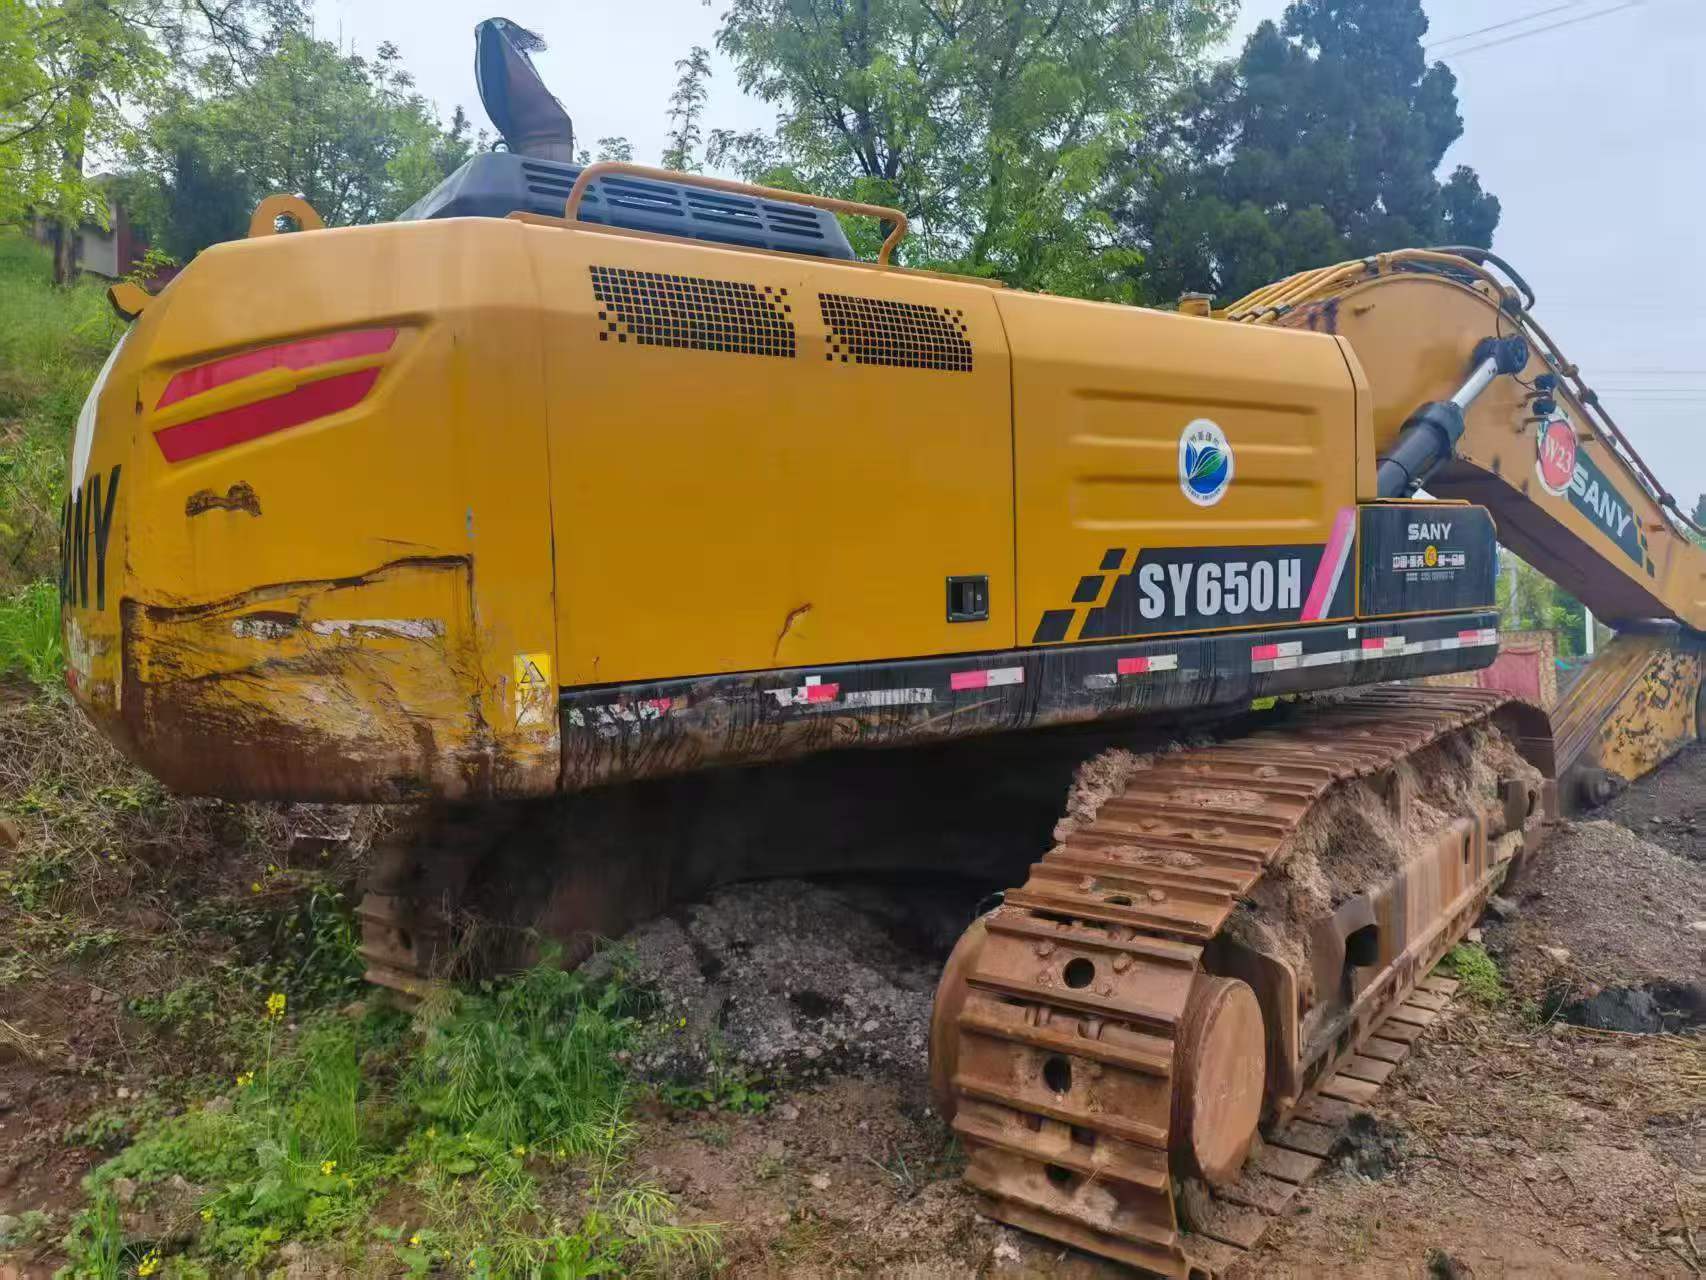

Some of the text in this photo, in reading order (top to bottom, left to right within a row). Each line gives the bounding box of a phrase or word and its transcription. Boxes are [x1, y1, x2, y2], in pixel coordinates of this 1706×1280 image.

[1570, 461, 1632, 538] SANY
[1407, 522, 1452, 541] SANY
[1139, 558, 1301, 619] SY650H
